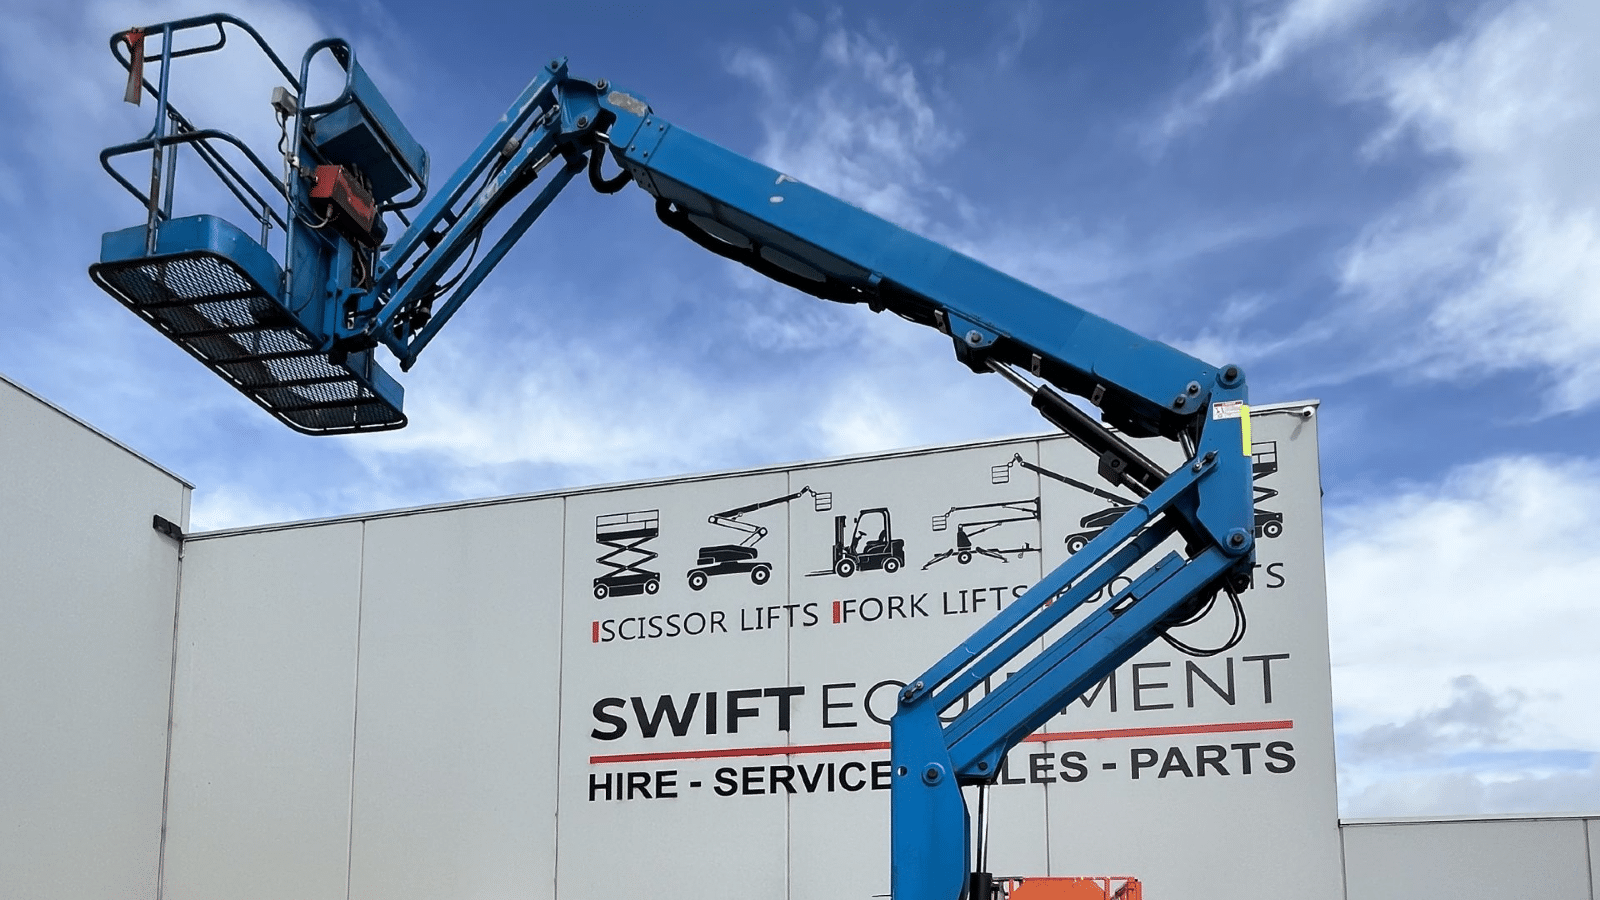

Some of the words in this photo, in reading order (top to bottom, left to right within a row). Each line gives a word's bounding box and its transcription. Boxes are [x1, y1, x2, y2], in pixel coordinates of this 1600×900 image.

[601, 610, 728, 643] SCISSOR
[741, 602, 819, 632] LIFTS
[842, 592, 929, 624] FORK
[590, 685, 806, 741] SWIFT
[588, 769, 678, 802] HIRE
[713, 760, 891, 797] SERVICE
[997, 750, 1089, 785] LES
[1130, 740, 1296, 780] PARTS
